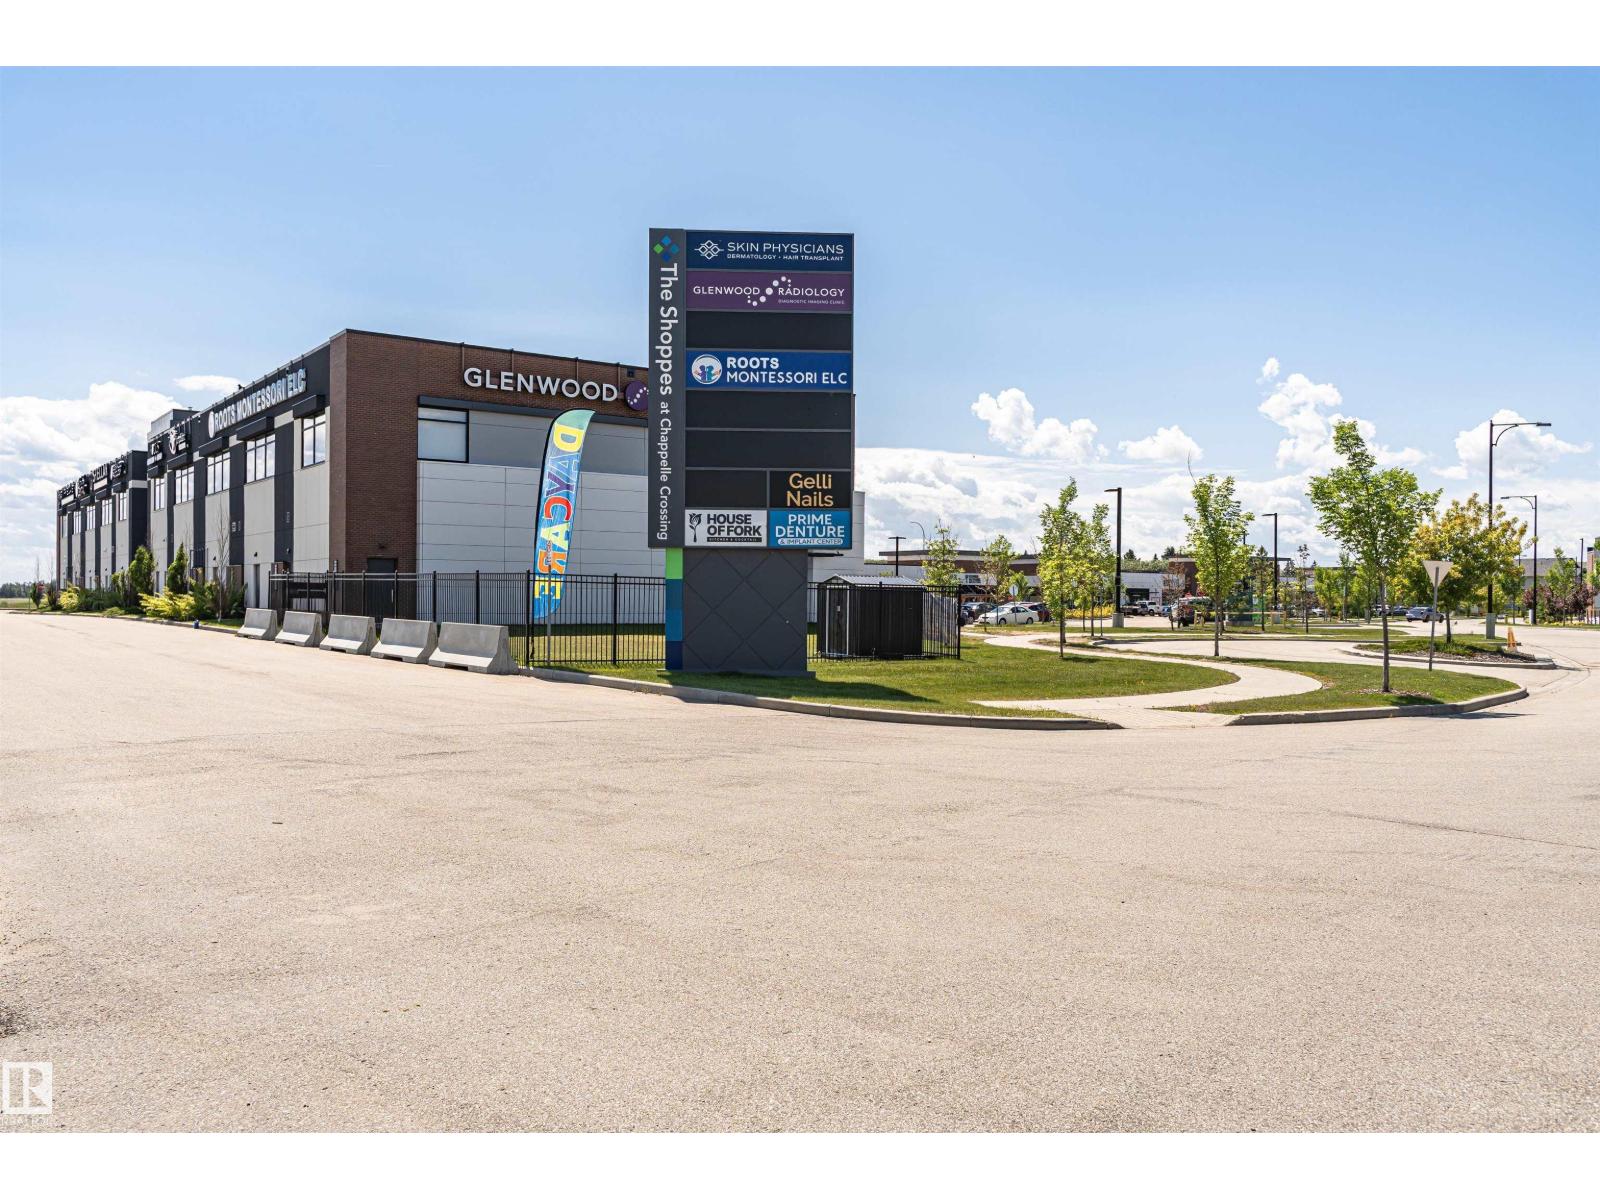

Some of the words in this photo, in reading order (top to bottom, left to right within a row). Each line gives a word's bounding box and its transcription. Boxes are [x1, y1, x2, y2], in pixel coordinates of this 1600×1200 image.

[727, 242, 759, 252] SKIN
[763, 243, 844, 254] PHYSICIANS
[660, 263, 679, 301] The
[693, 286, 760, 295] GLENWOOD
[778, 287, 845, 297] RADIOLOGY
[655, 306, 679, 395] Shoppes
[727, 357, 779, 369] ROOTS
[727, 371, 817, 384] MONTESSORI
[822, 372, 848, 384] ELC
[463, 367, 619, 402] GLENWOOD
[214, 404, 236, 431] ROOTS
[237, 377, 287, 422] MONTESSORI
[287, 368, 307, 398] ELC
[660, 402, 670, 415] at
[657, 419, 672, 482] Chappelle
[788, 472, 832, 489] Gelli
[786, 491, 834, 508] Nails
[656, 486, 671, 541] Crossing
[706, 513, 752, 525] HOUSE
[788, 513, 832, 525] PRIME
[706, 525, 725, 536] OF
[726, 525, 762, 536] FORK
[775, 525, 845, 538] DENTURE
